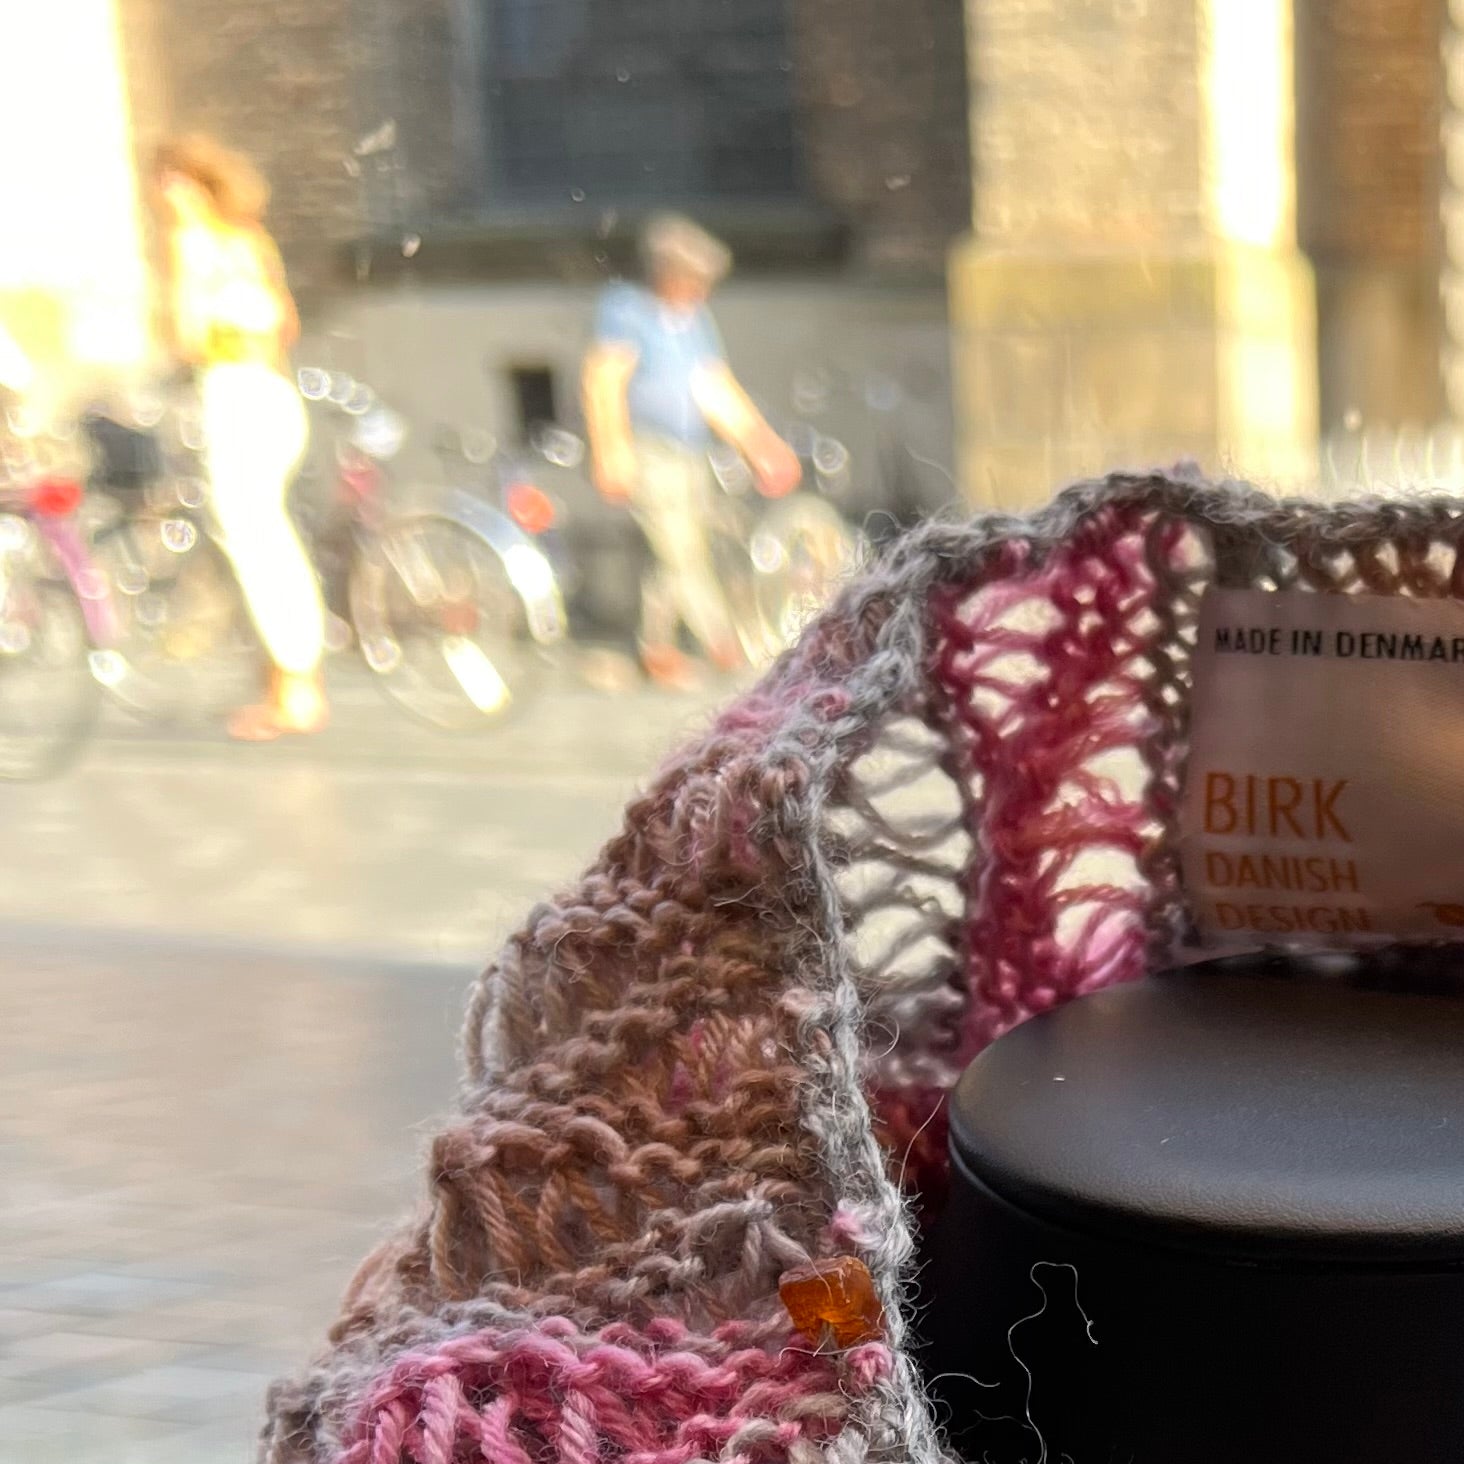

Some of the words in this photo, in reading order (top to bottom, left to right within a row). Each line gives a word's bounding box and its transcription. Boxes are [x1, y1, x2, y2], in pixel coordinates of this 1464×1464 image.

[1215, 628, 1280, 655] MADE
[1292, 631, 1323, 657] IN
[1204, 772, 1351, 842] BIRK
[1207, 853, 1358, 892] DANISH
[1216, 904, 1372, 933] DESIGN
